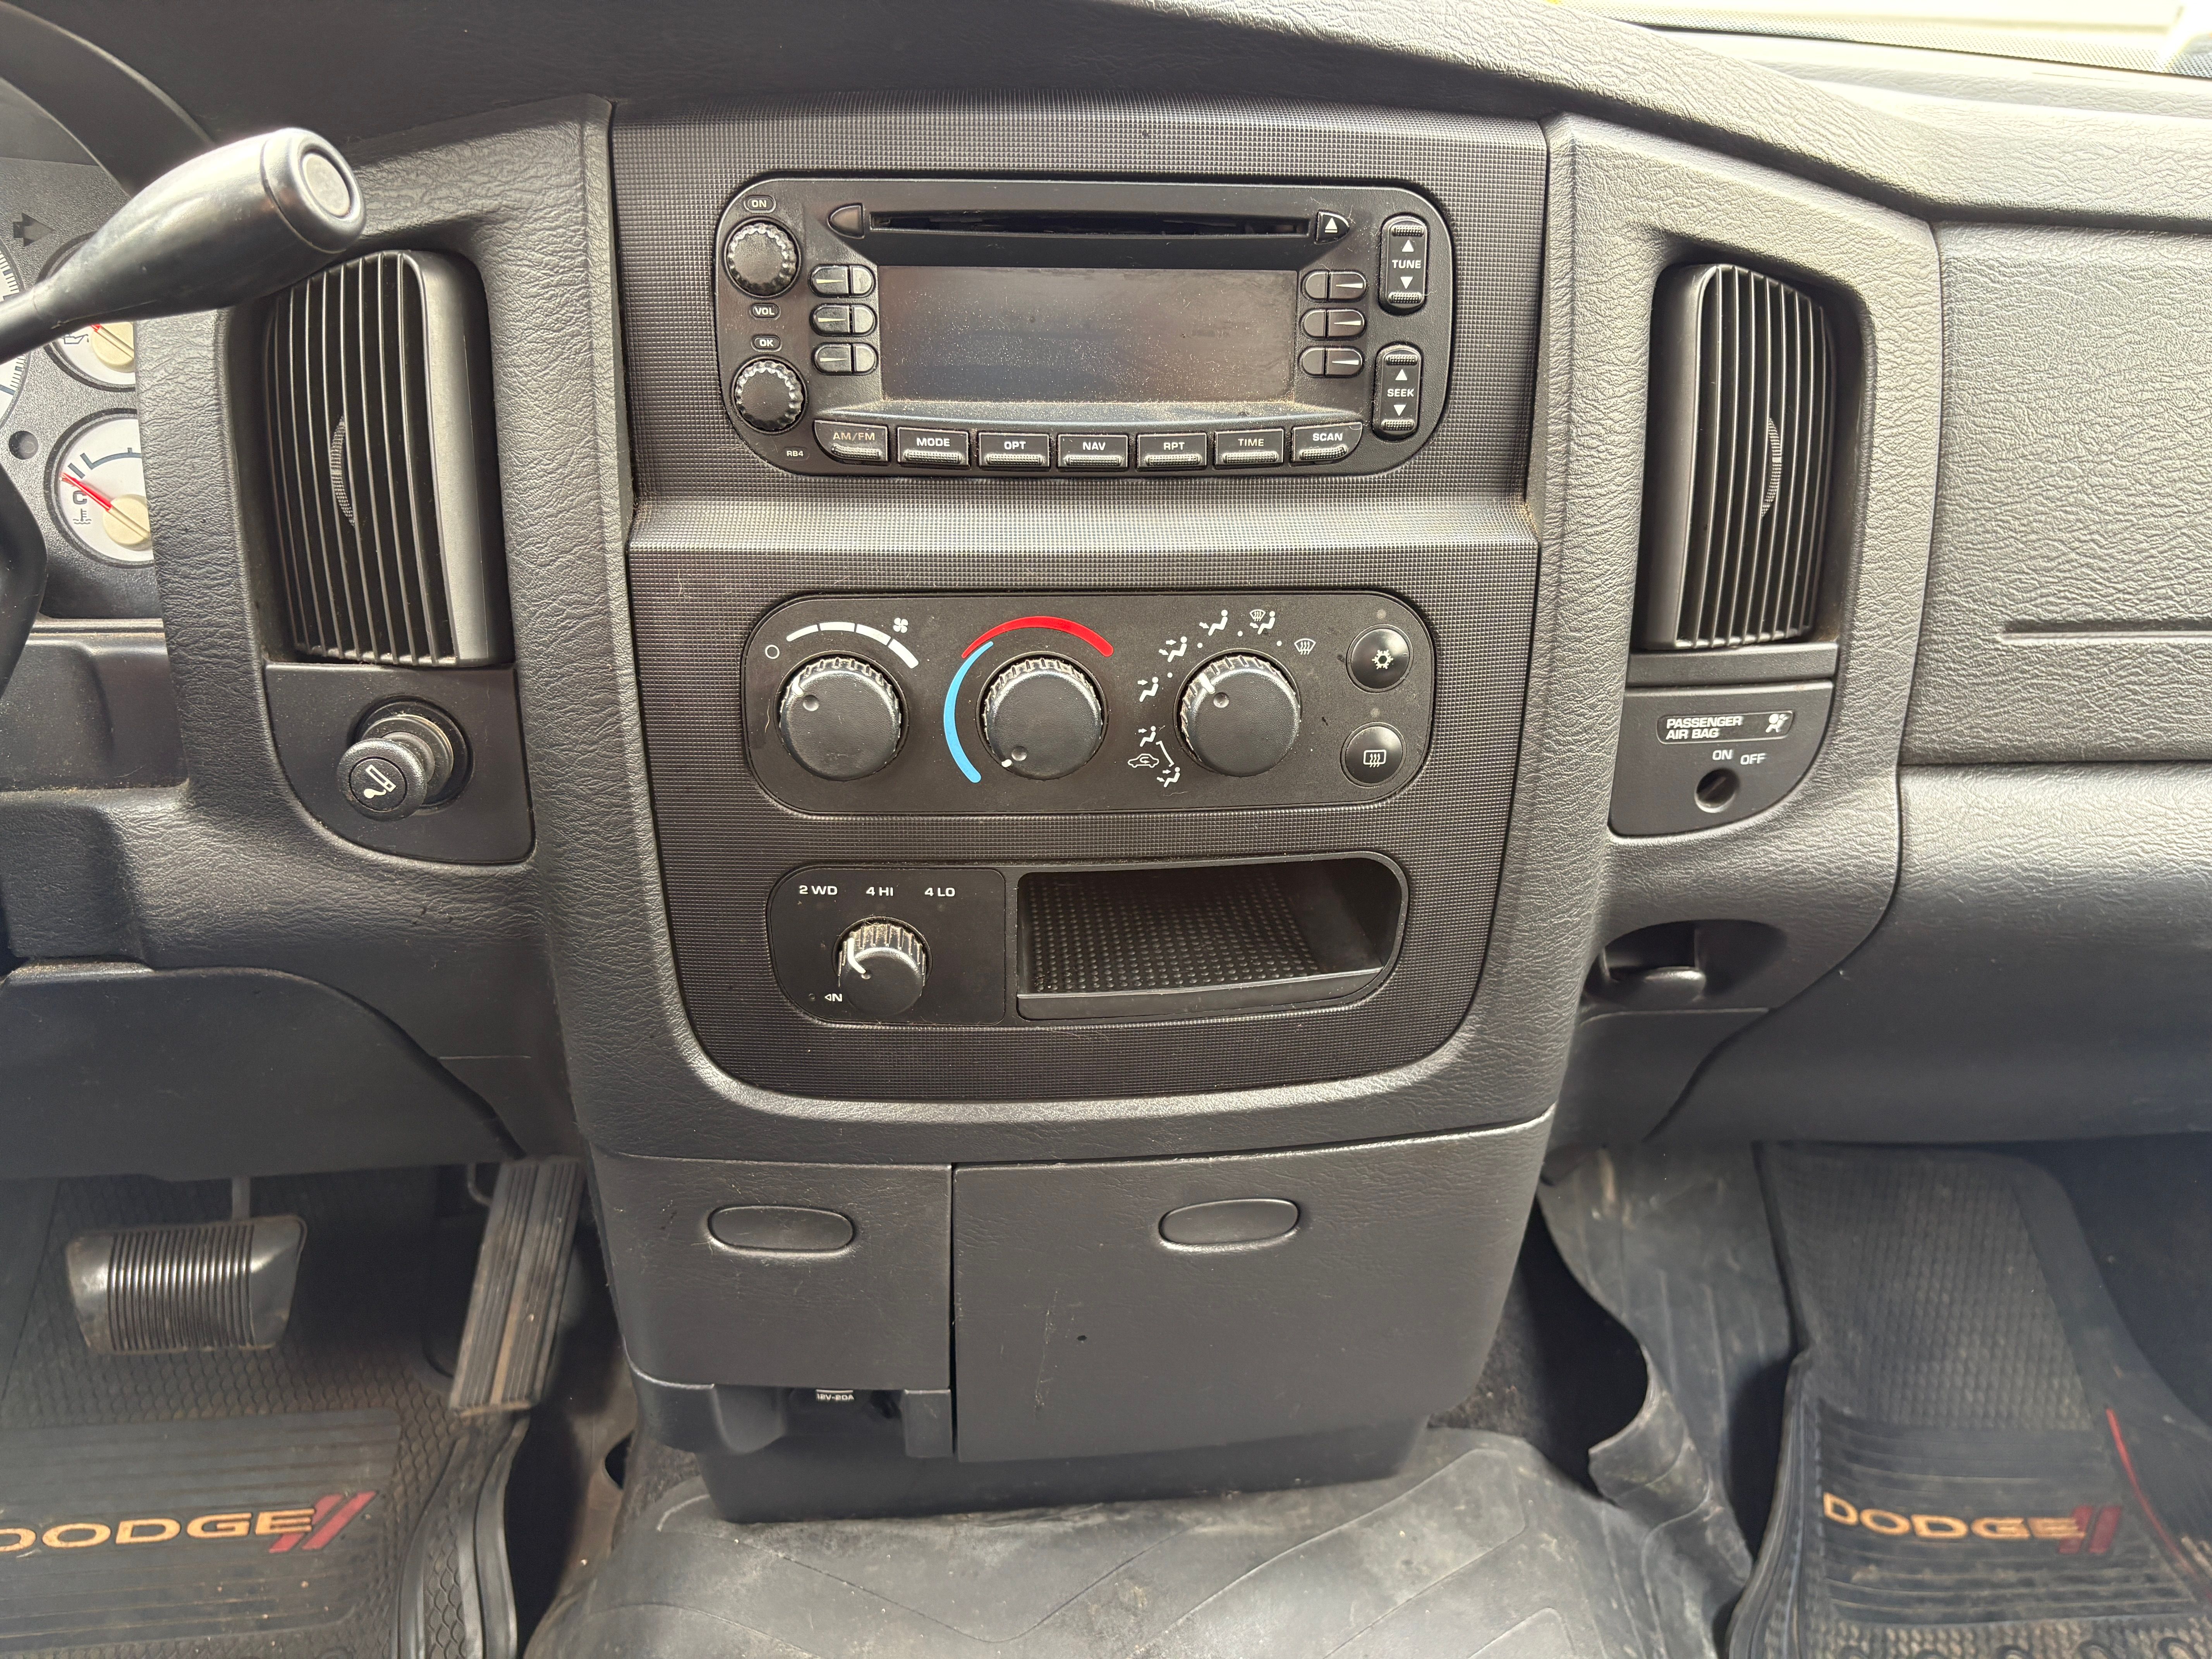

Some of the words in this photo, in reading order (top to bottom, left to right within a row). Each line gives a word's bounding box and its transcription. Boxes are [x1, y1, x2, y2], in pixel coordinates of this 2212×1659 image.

[751, 199, 767, 208] ON
[1392, 260, 1421, 269] TUNE
[755, 307, 775, 316] VOL
[1387, 388, 1414, 398] SEEK
[833, 431, 875, 442] AM/FM
[1312, 433, 1343, 441] SCAN
[916, 437, 950, 447] MODE
[1004, 441, 1026, 450] OPT
[1082, 441, 1106, 451] NAV
[1163, 441, 1184, 451] RPT
[1238, 438, 1264, 447] TIME
[72, 490, 87, 505] C
[1666, 716, 1743, 728] PASSENGER
[1666, 729, 1688, 740] AIR
[1692, 728, 1720, 738] BAG
[1712, 750, 1733, 760] ON
[1740, 753, 1767, 765] OFF
[799, 885, 808, 895] 2
[812, 886, 837, 895] WD
[866, 887, 875, 896] 4
[879, 887, 893, 896] HI
[925, 888, 934, 896] 4
[938, 888, 955, 896] LO
[1824, 1492, 2086, 1539] DODGE
